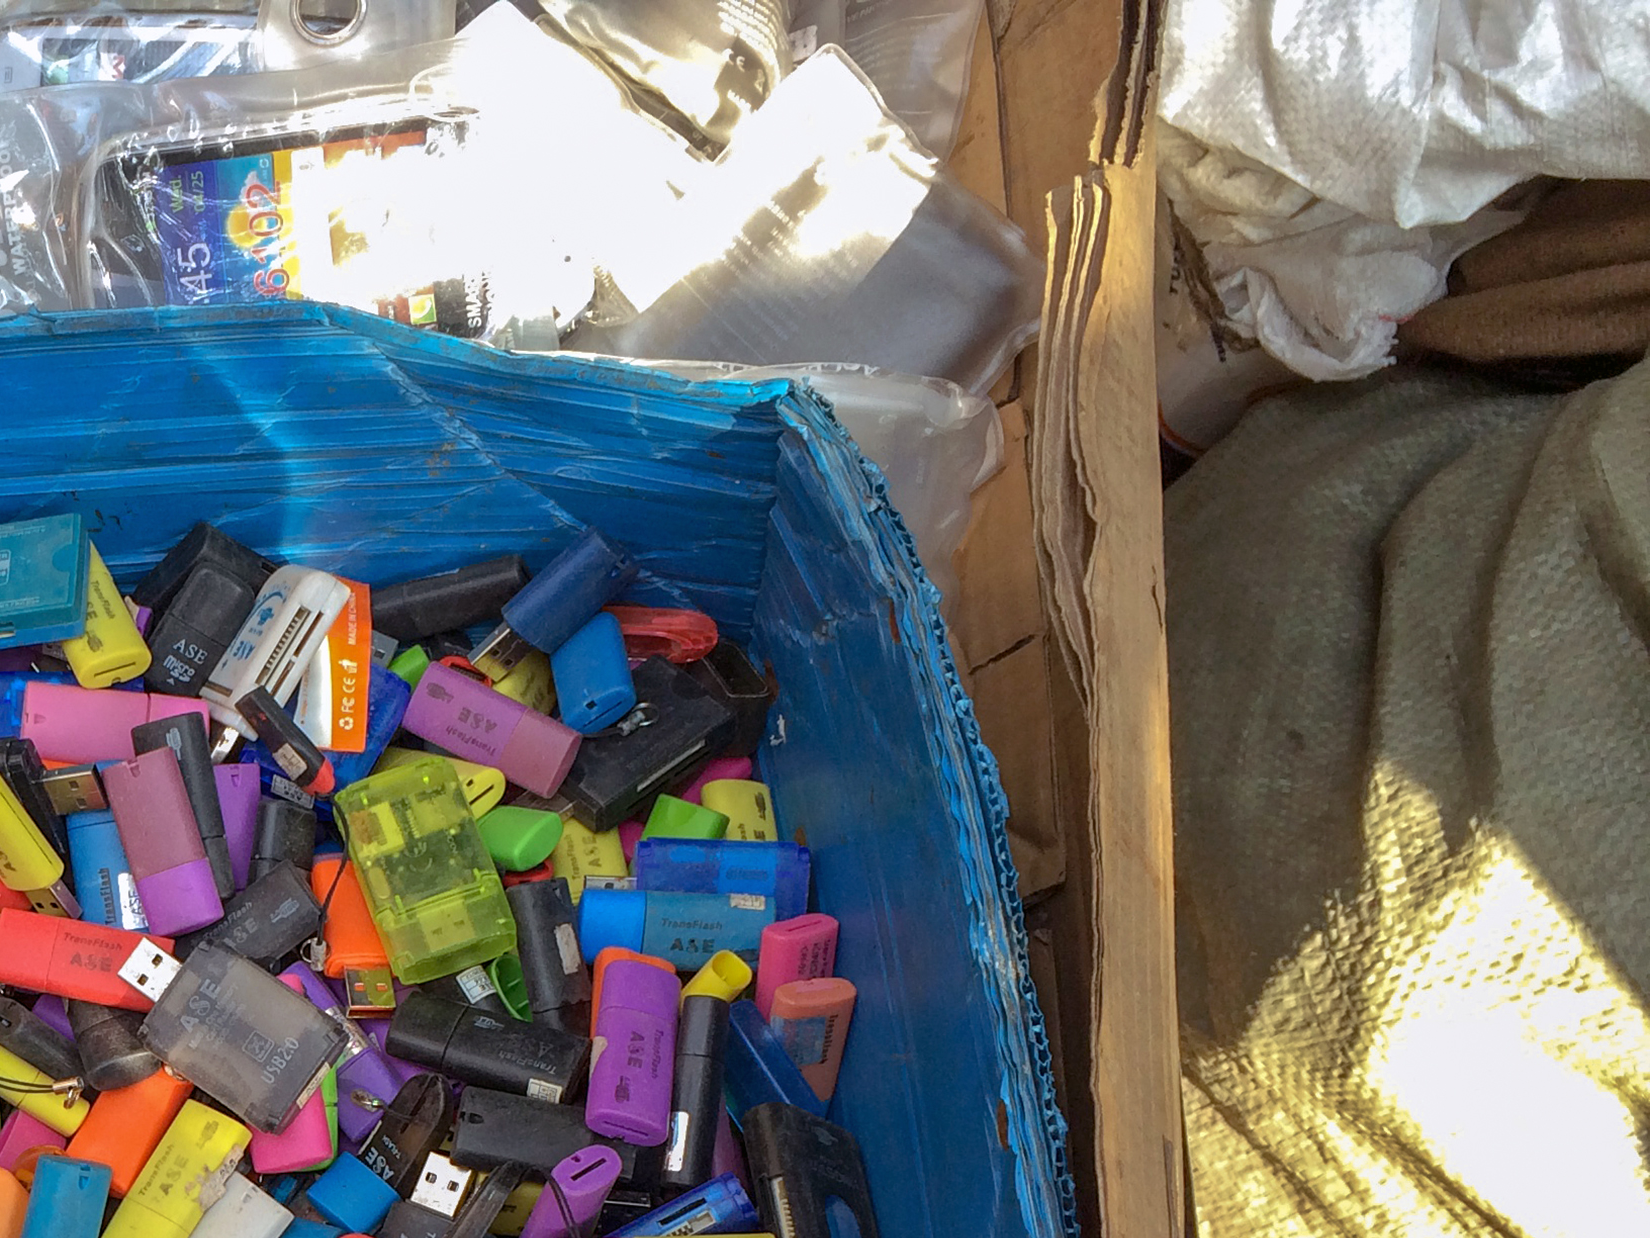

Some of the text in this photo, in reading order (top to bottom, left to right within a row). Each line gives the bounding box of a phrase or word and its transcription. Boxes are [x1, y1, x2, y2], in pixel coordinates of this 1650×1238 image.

[189, 169, 208, 213] 04/25
[170, 637, 210, 668] ASE
[455, 706, 500, 735] ASE
[443, 725, 498, 756] TransFlash
[100, 867, 114, 927] TransFlash
[660, 916, 724, 932] TransFlash
[62, 931, 124, 952] TransFlash
[671, 937, 715, 954] ASE
[69, 951, 113, 972] ASE
[175, 977, 226, 1036] ASE
[259, 1035, 302, 1085] USB2.0
[627, 1031, 643, 1069] ASE
[649, 1029, 663, 1079] TransFlash
[358, 1146, 397, 1185] ASE
